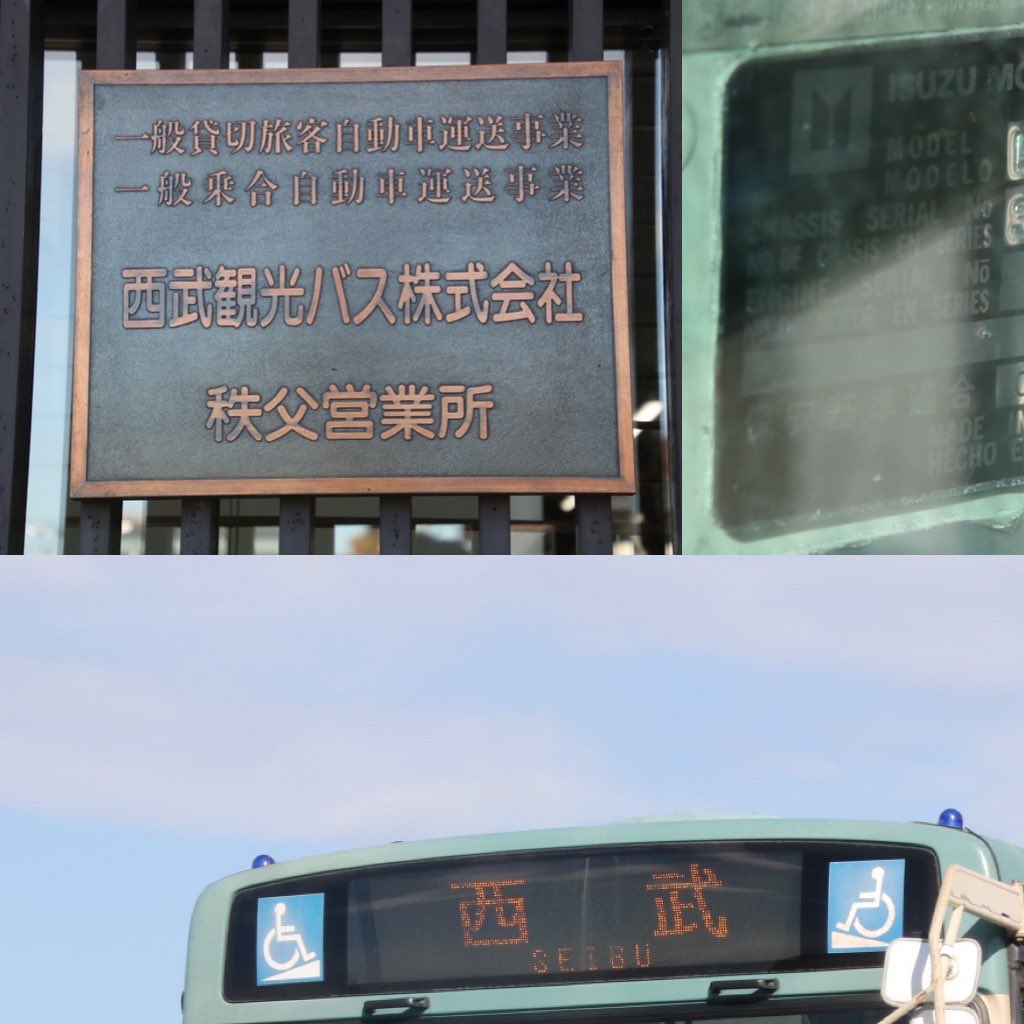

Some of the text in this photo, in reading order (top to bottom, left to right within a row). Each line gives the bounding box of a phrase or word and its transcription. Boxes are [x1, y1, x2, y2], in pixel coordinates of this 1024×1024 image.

[115, 112, 585, 157] 一般貸切旅客自動車運送事業
[115, 164, 585, 208] 一般乗合自動車運送事業
[121, 260, 584, 330] 西武観光バス株式会社
[205, 383, 495, 442] 秩父営業所
[450, 862, 728, 948] 西武
[531, 946, 652, 975] SEIBU
